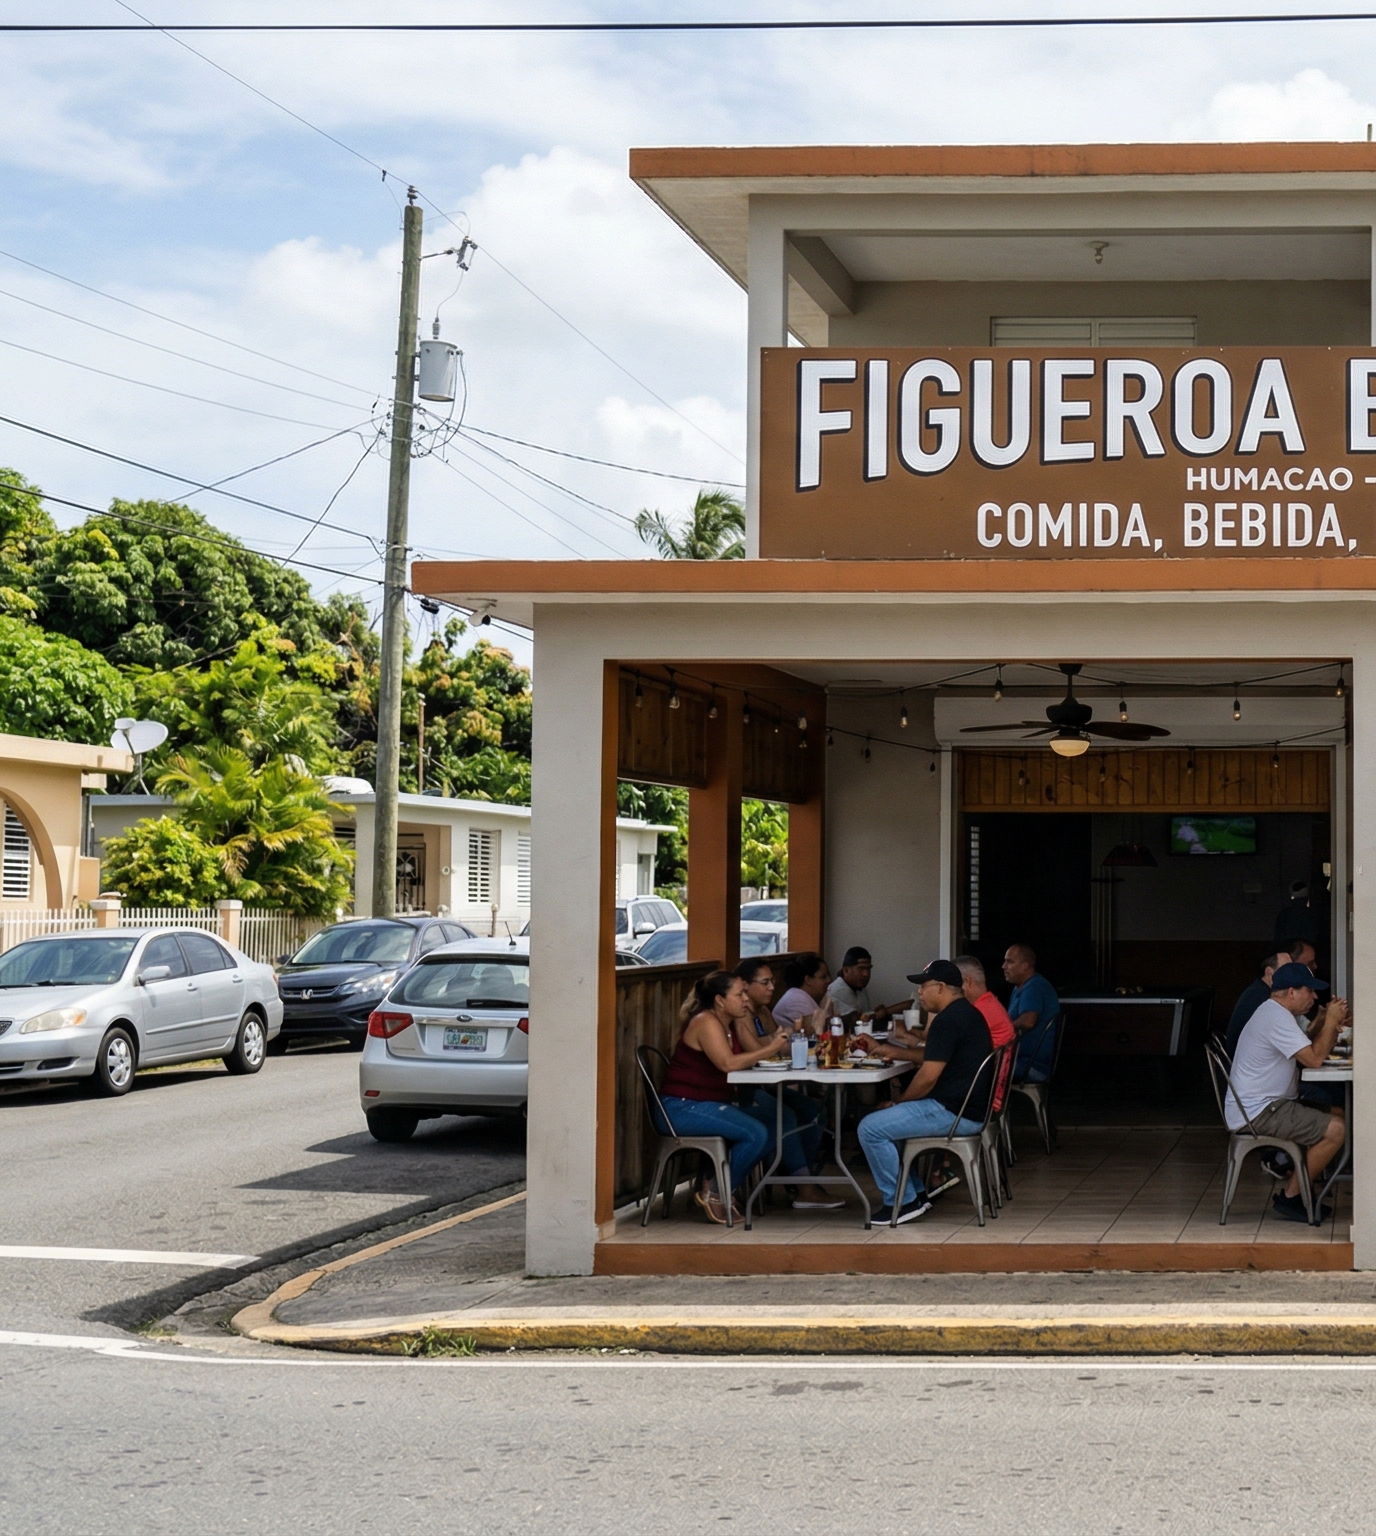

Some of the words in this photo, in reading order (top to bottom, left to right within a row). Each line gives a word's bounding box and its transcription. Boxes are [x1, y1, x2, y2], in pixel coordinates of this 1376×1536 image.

[797, 358, 1305, 489] FIGUEROA
[1186, 466, 1354, 492] HUMACAO
[977, 502, 1163, 553] COMIDA,
[1183, 502, 1357, 553] BEBIDA,
